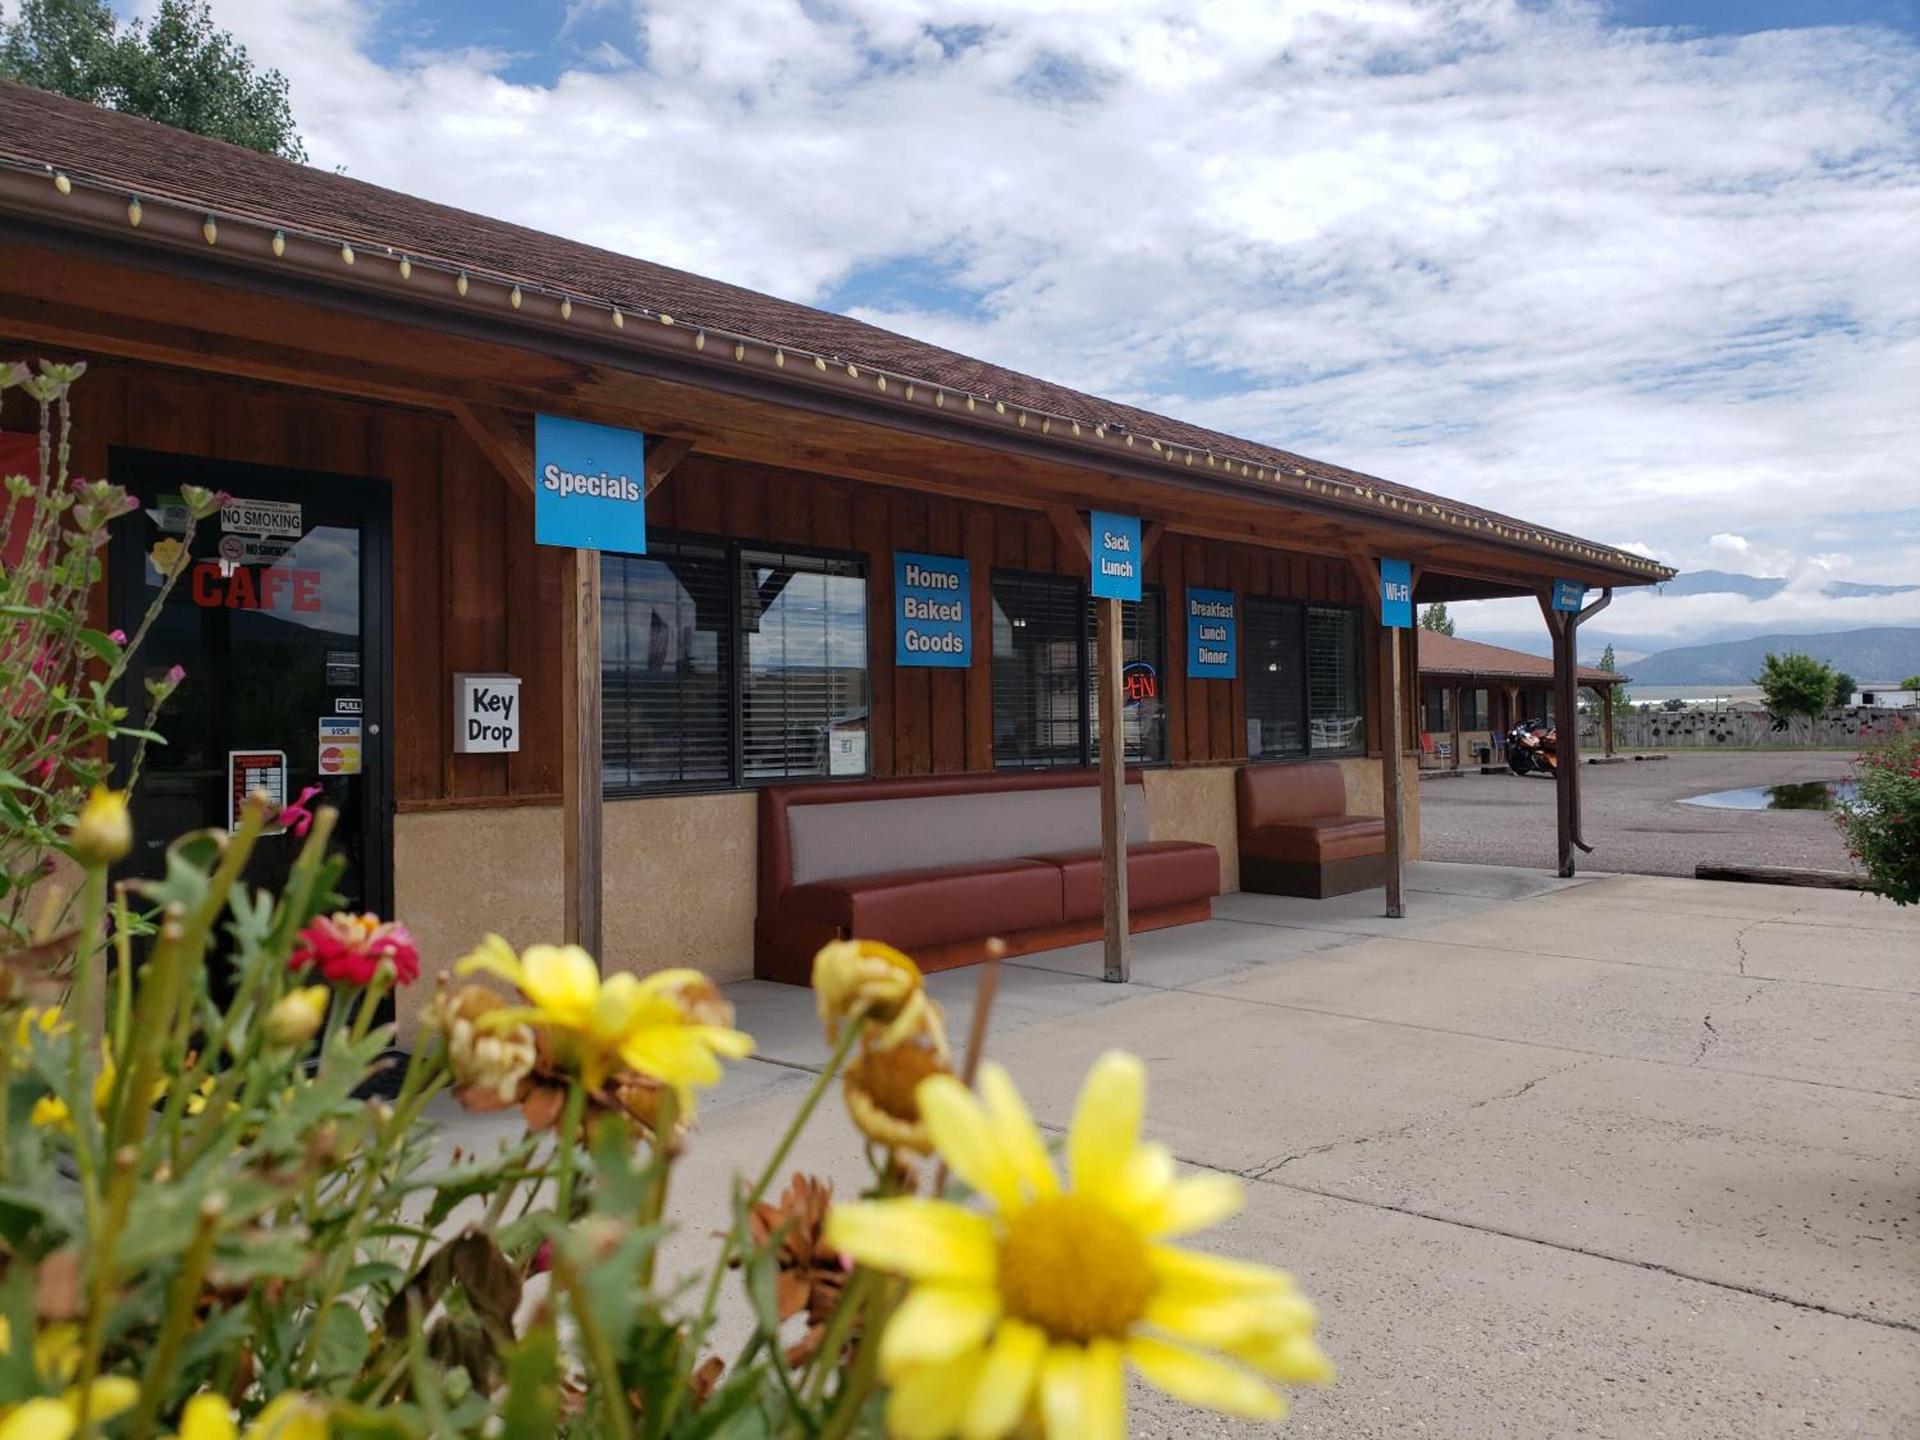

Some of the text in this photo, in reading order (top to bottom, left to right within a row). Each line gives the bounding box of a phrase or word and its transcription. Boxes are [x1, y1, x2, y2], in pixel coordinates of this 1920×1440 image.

[543, 464, 641, 502] Specials
[222, 510, 300, 529] NO SMOKING
[1103, 531, 1130, 553] Sack
[905, 564, 960, 591] Home
[1100, 557, 1133, 578] Lunch
[192, 563, 321, 612] CAFE
[1384, 582, 1410, 603] Wi-Fi
[903, 597, 962, 623] Baked
[1191, 600, 1234, 619] Breakfast
[904, 631, 964, 654] Goods
[1199, 625, 1226, 642] Lunch
[1198, 647, 1229, 665] Dinner
[1123, 673, 1155, 700] PEN
[339, 701, 360, 710] PULL
[472, 687, 514, 720] Key
[331, 727, 350, 736] VISA
[467, 718, 513, 748] Drop
